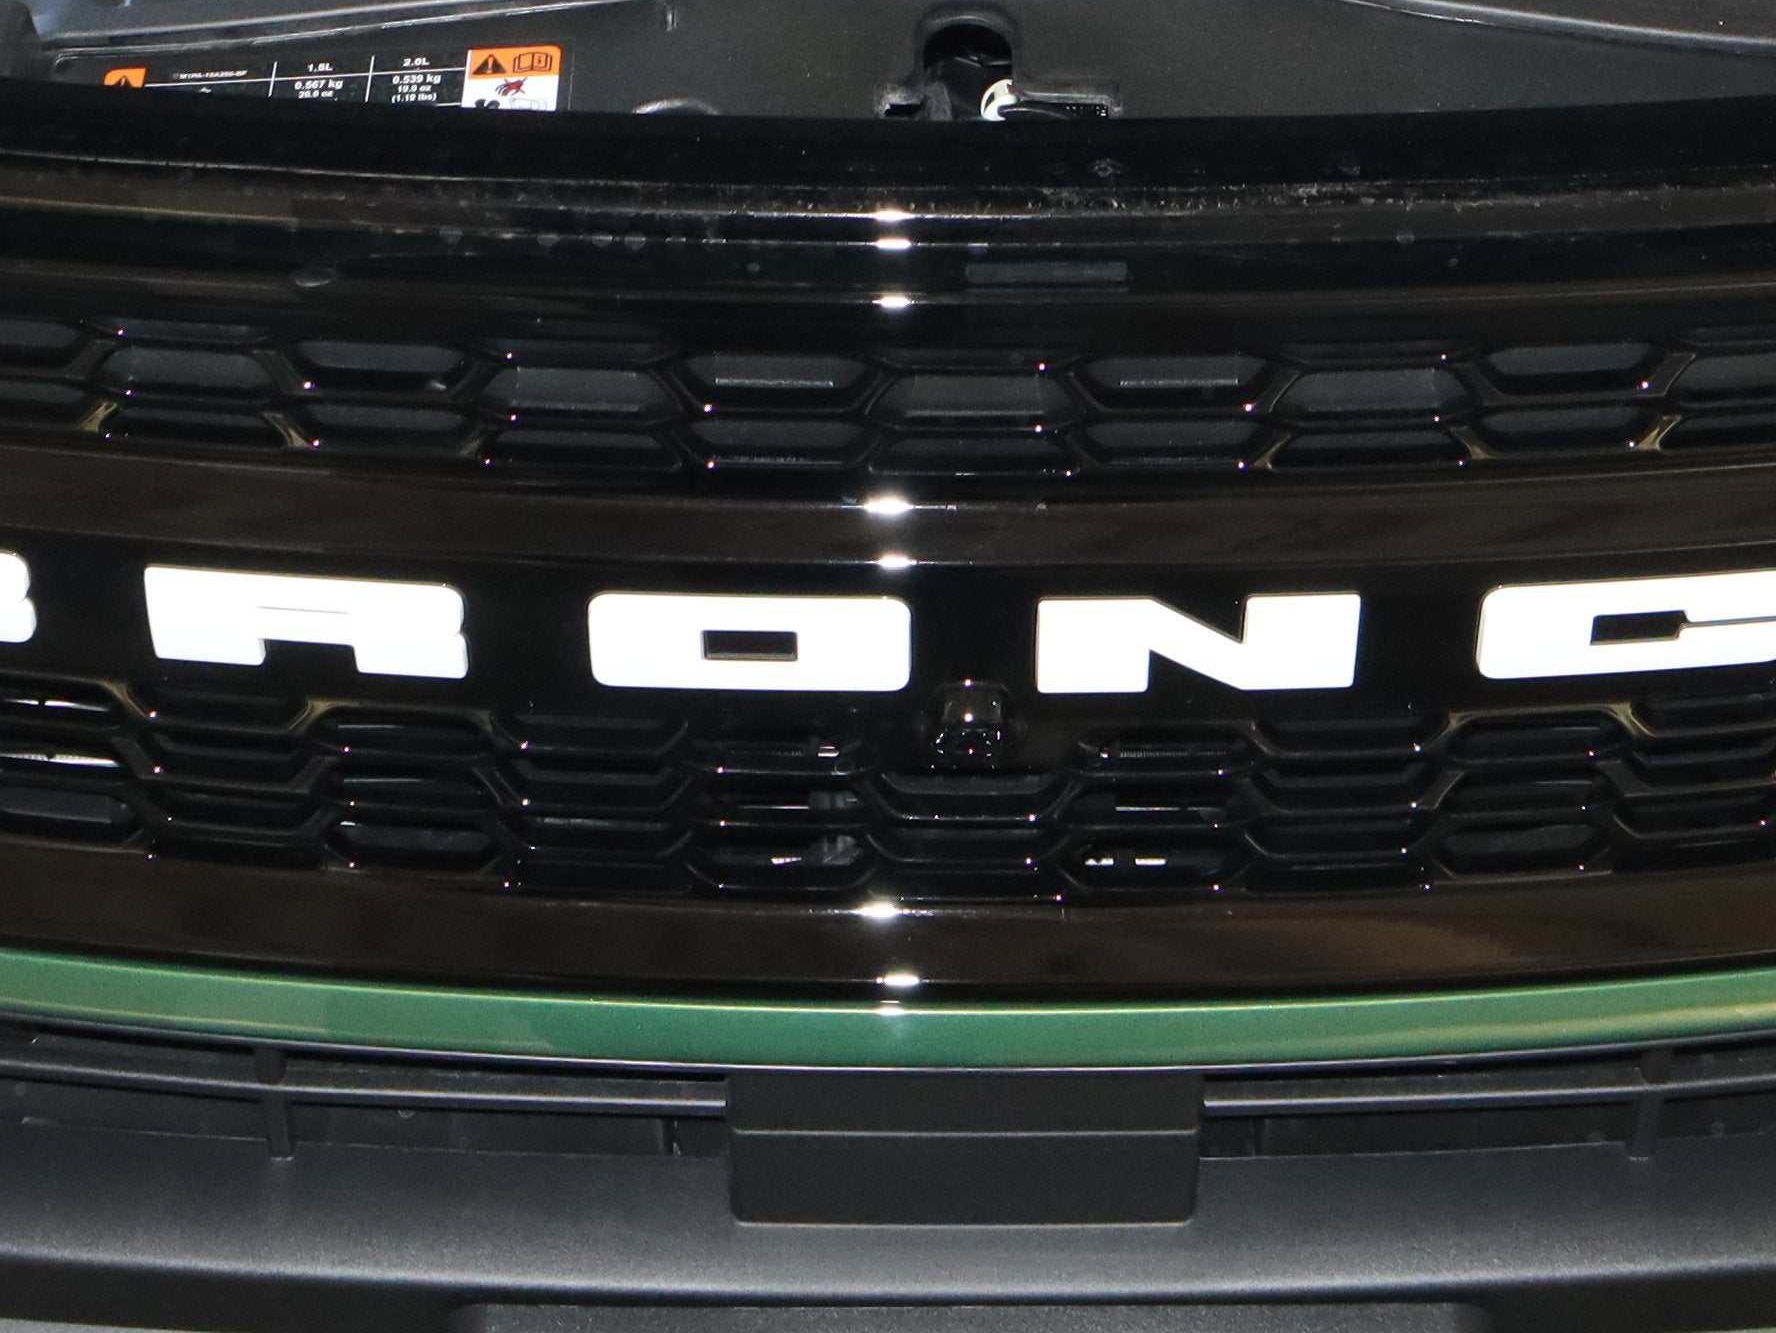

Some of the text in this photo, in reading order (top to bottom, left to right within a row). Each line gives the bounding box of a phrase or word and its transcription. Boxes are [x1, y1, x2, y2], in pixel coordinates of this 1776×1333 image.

[402, 56, 430, 67] 2.0L
[294, 78, 344, 90] 0.567 kg
[392, 73, 442, 85] 0.539 kg
[418, 84, 432, 92] oz
[320, 90, 334, 98] oz
